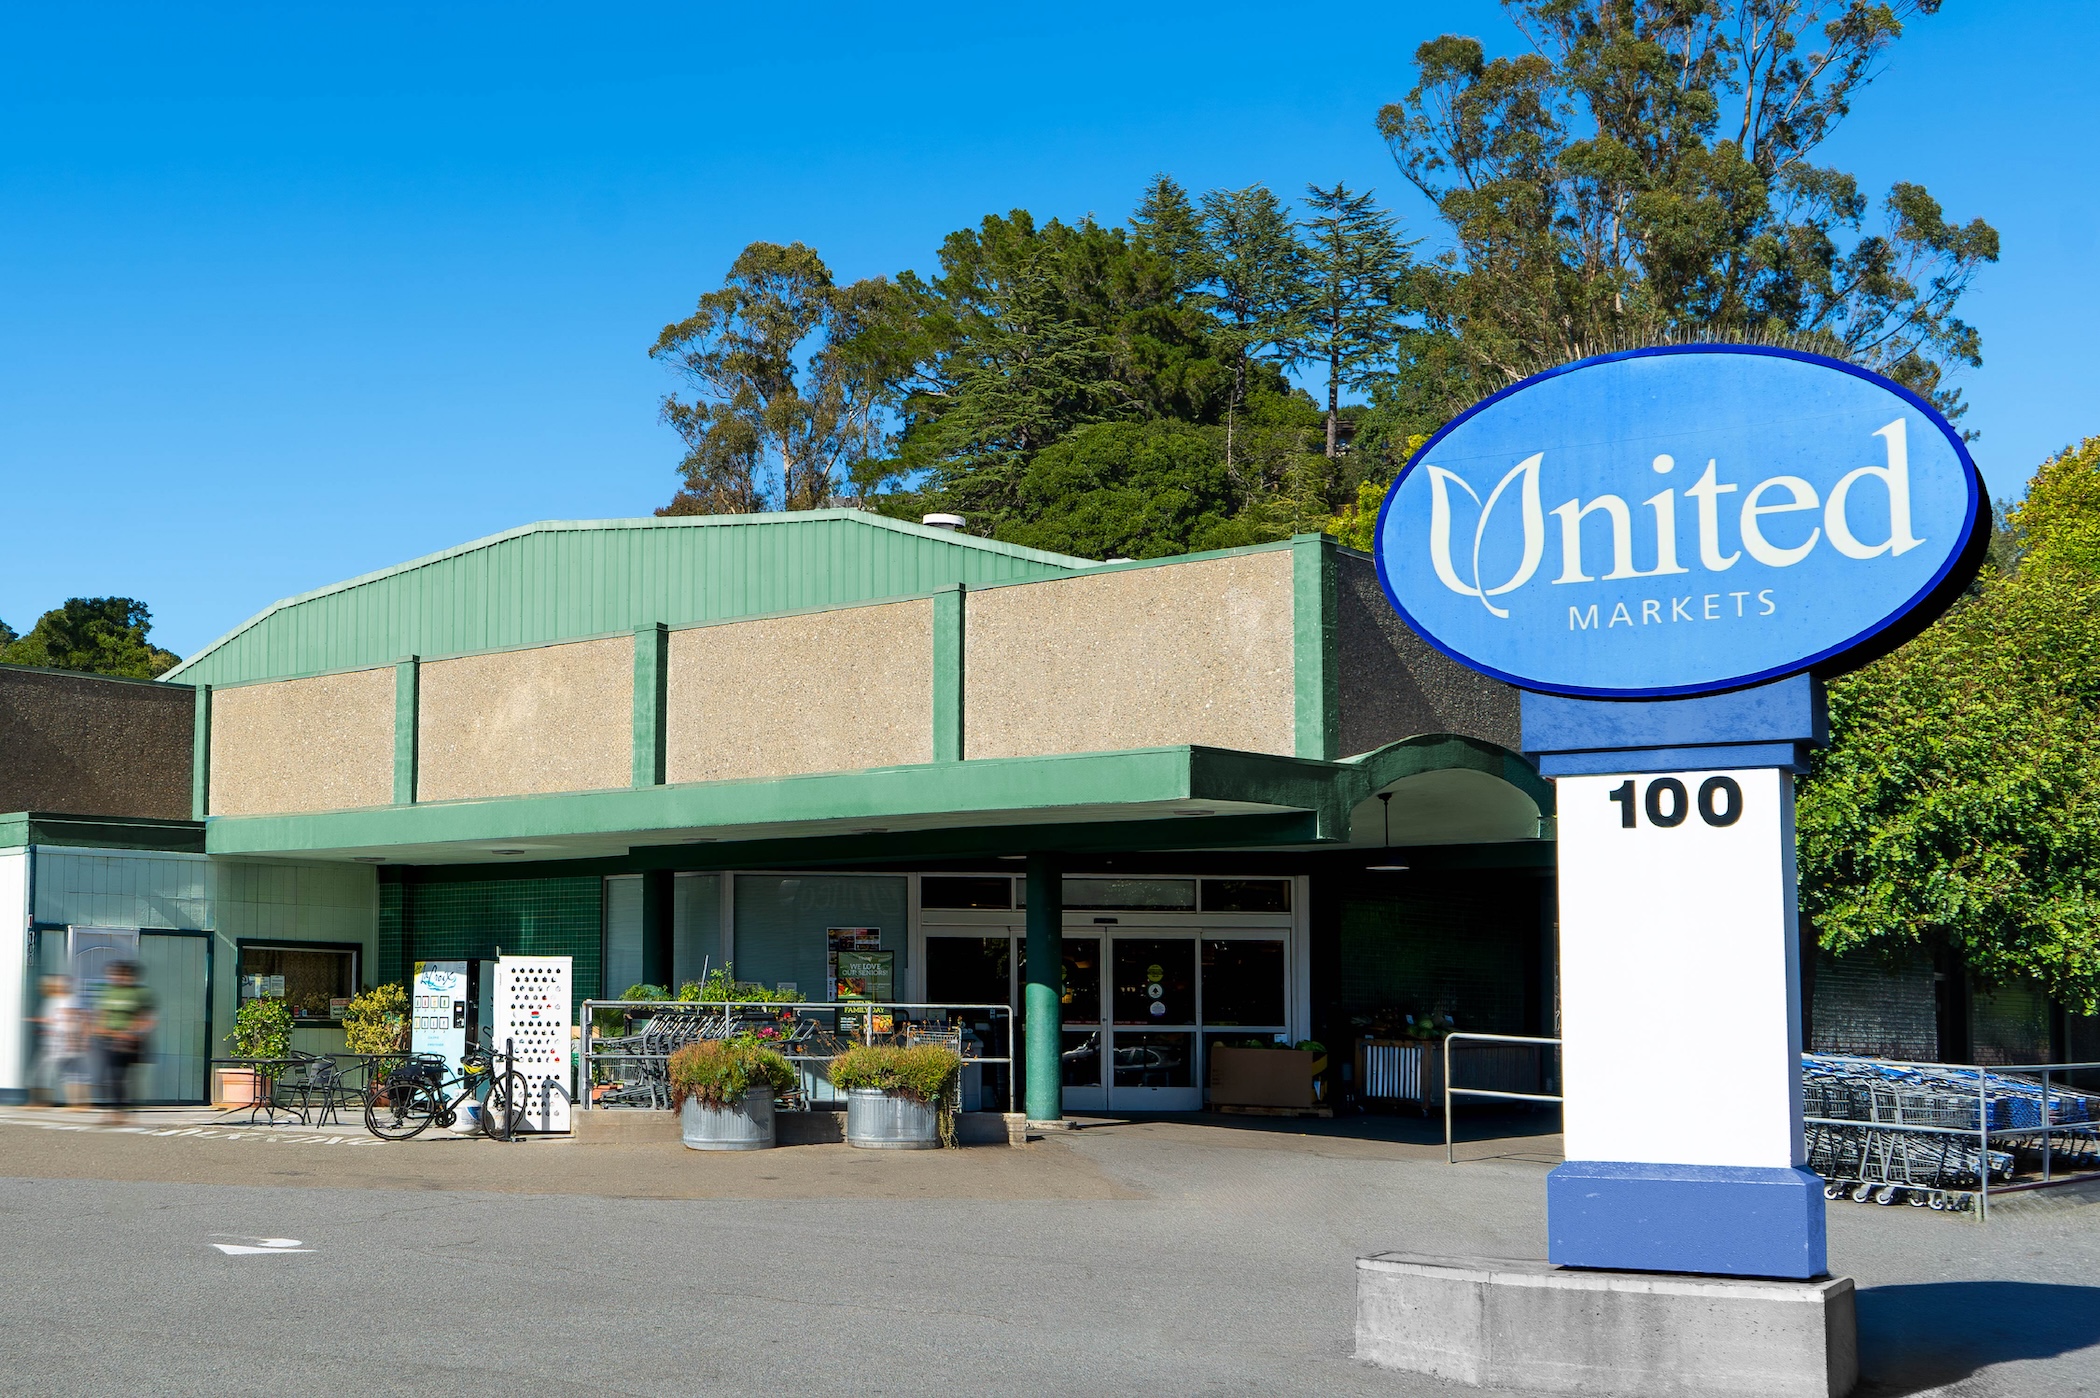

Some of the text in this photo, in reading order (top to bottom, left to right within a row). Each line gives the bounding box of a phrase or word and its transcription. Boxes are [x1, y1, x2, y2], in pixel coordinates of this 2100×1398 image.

[1427, 418, 1926, 619] United
[1569, 589, 1775, 631] MARKETS
[1609, 776, 1743, 829] 100
